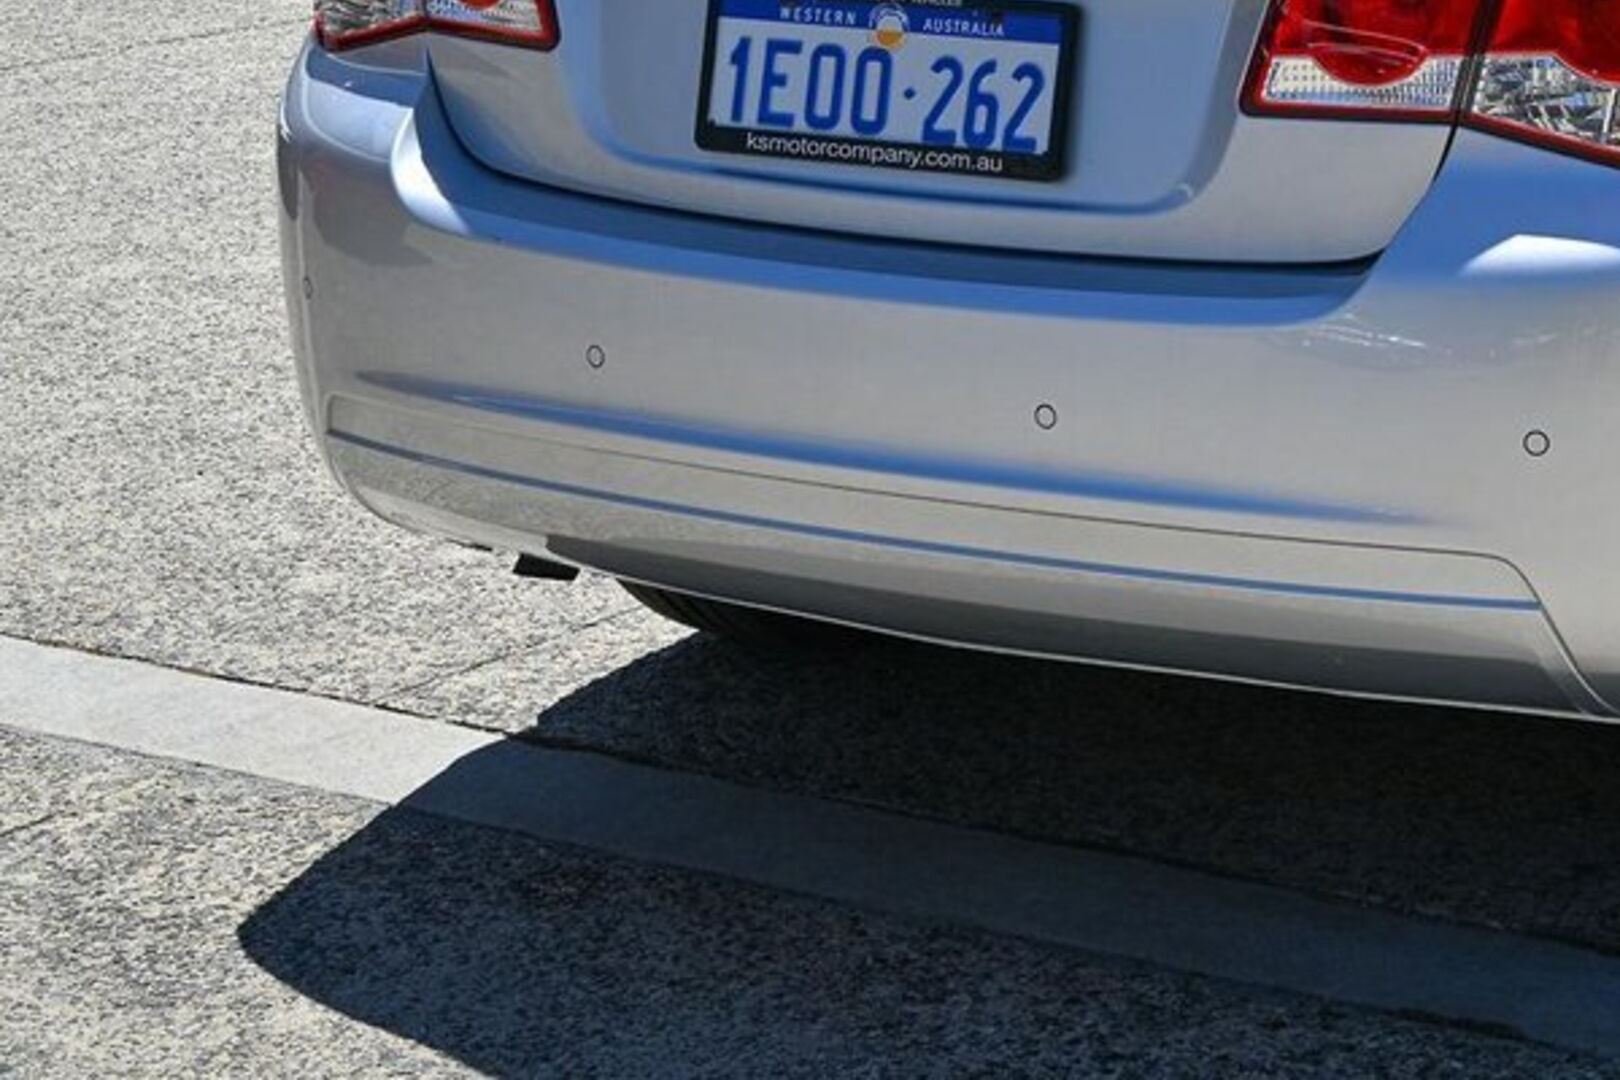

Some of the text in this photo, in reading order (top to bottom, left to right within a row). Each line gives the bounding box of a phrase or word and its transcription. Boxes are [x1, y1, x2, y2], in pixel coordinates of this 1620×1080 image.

[779, 5, 1005, 37] WESTERN AUSTRALIA
[745, 132, 1004, 174] ksmotorcompany.com.au
